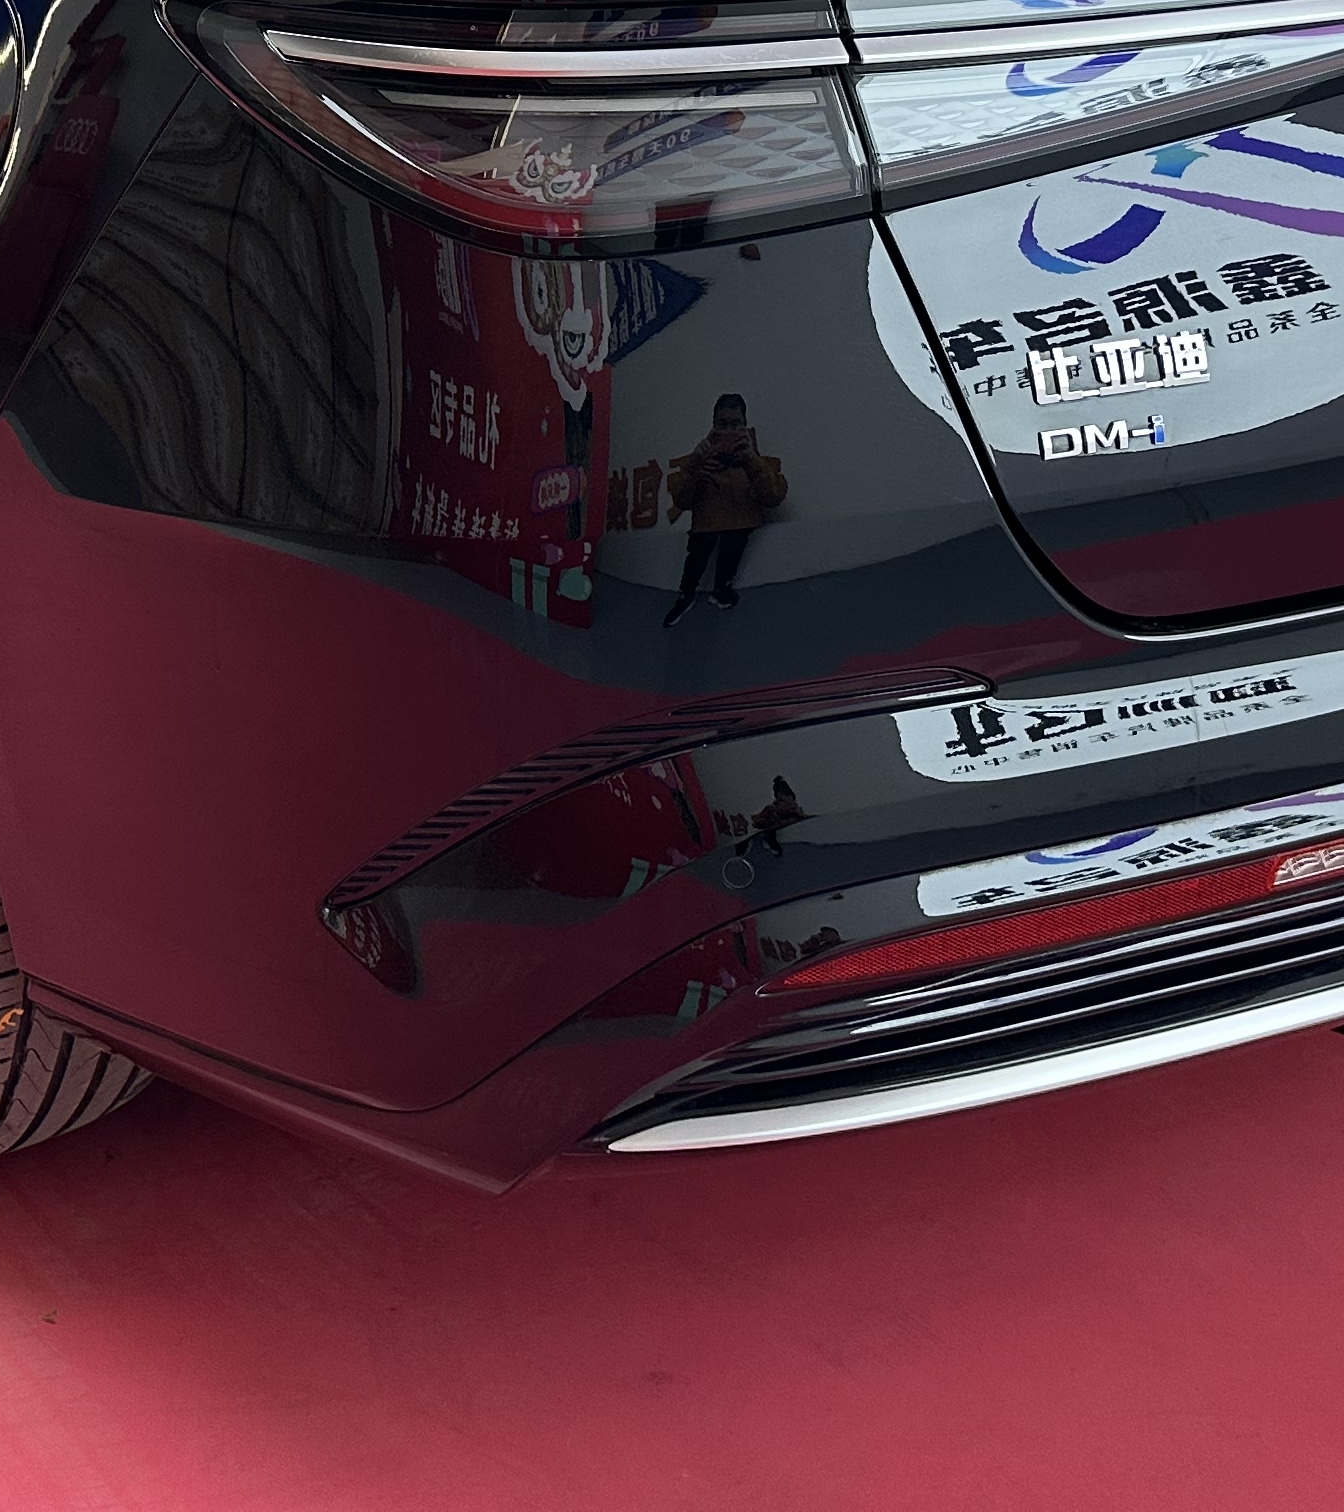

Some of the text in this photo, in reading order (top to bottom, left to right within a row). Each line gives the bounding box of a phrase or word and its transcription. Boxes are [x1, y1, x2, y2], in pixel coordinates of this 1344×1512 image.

[1026, 330, 1211, 406] 比亚迪
[1037, 414, 1166, 461] DM-i
